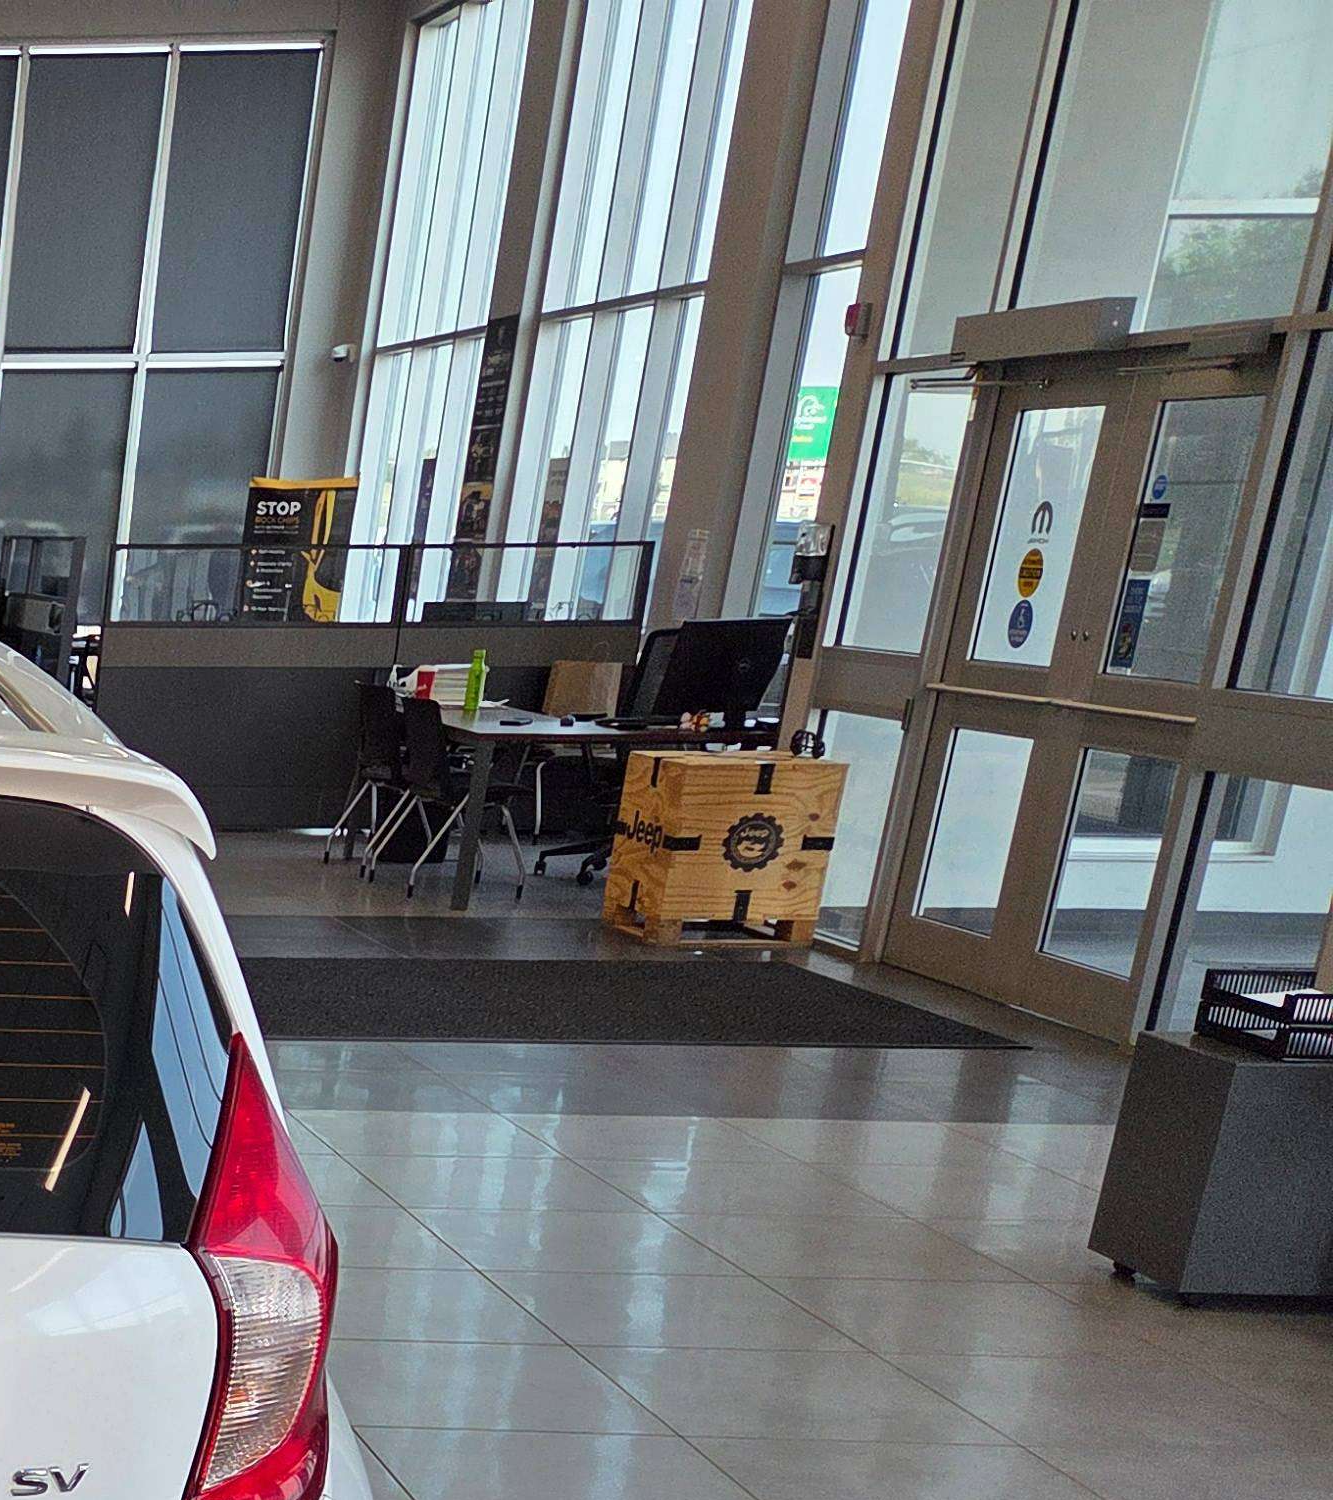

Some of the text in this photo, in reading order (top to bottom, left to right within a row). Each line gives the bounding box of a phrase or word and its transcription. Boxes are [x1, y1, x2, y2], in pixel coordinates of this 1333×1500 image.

[256, 501, 302, 516] STOP
[627, 810, 663, 853] Jeep
[740, 827, 769, 838] Jeep
[10, 1463, 90, 1497] SV
